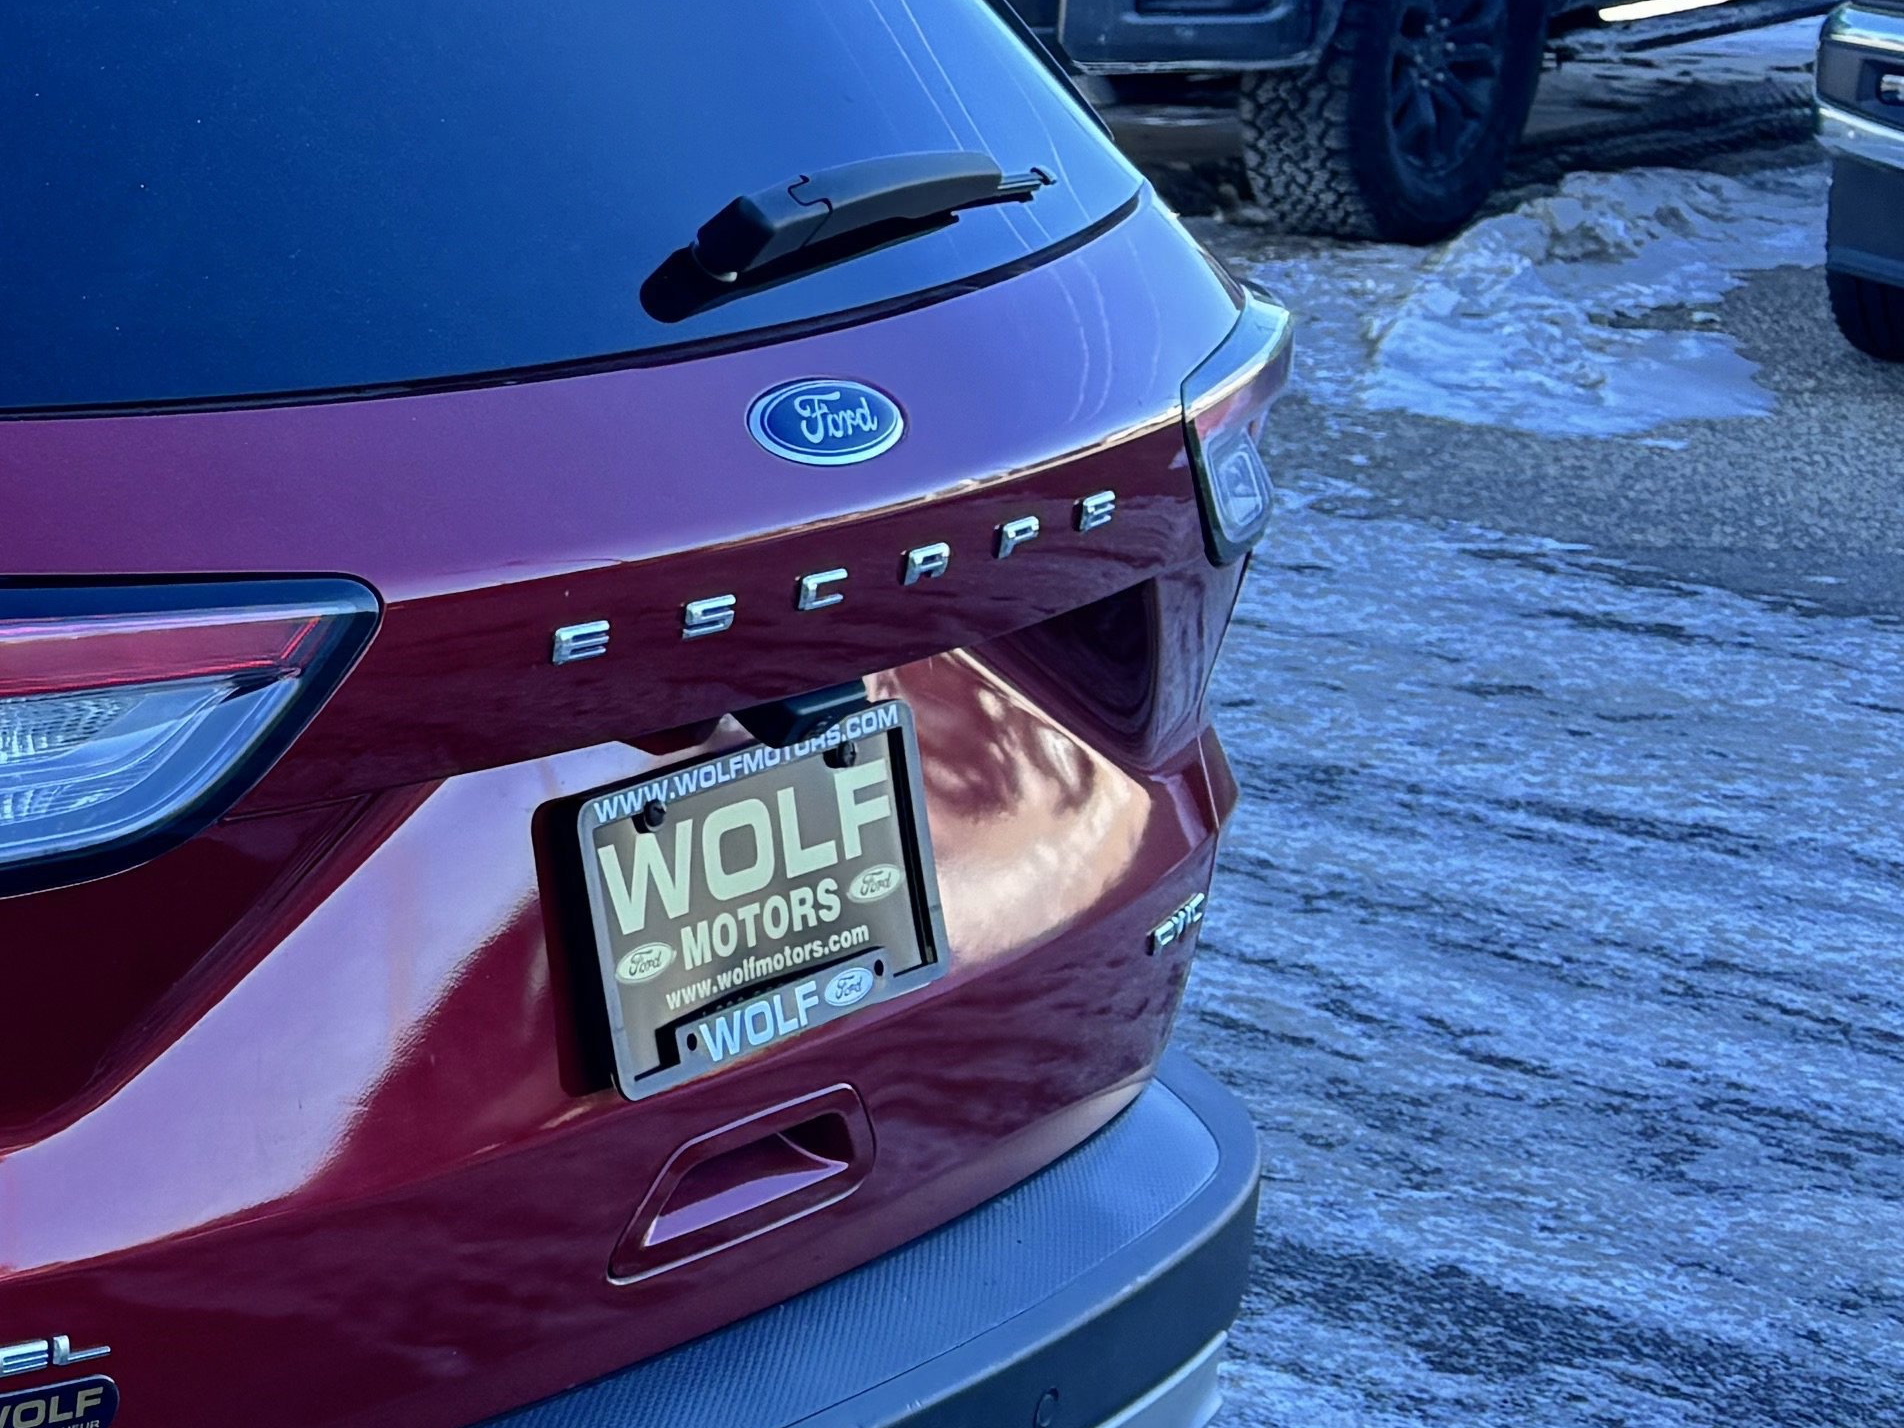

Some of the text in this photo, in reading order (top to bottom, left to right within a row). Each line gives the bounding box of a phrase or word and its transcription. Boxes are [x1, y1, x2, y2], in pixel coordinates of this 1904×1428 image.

[794, 390, 879, 445] Ford
[553, 490, 1117, 666] ESCAPE
[597, 758, 894, 935] WOLF
[665, 922, 870, 1010] www.wolfmotors.com
[680, 879, 842, 971] MOTORS
[700, 980, 820, 1062] WOLF
